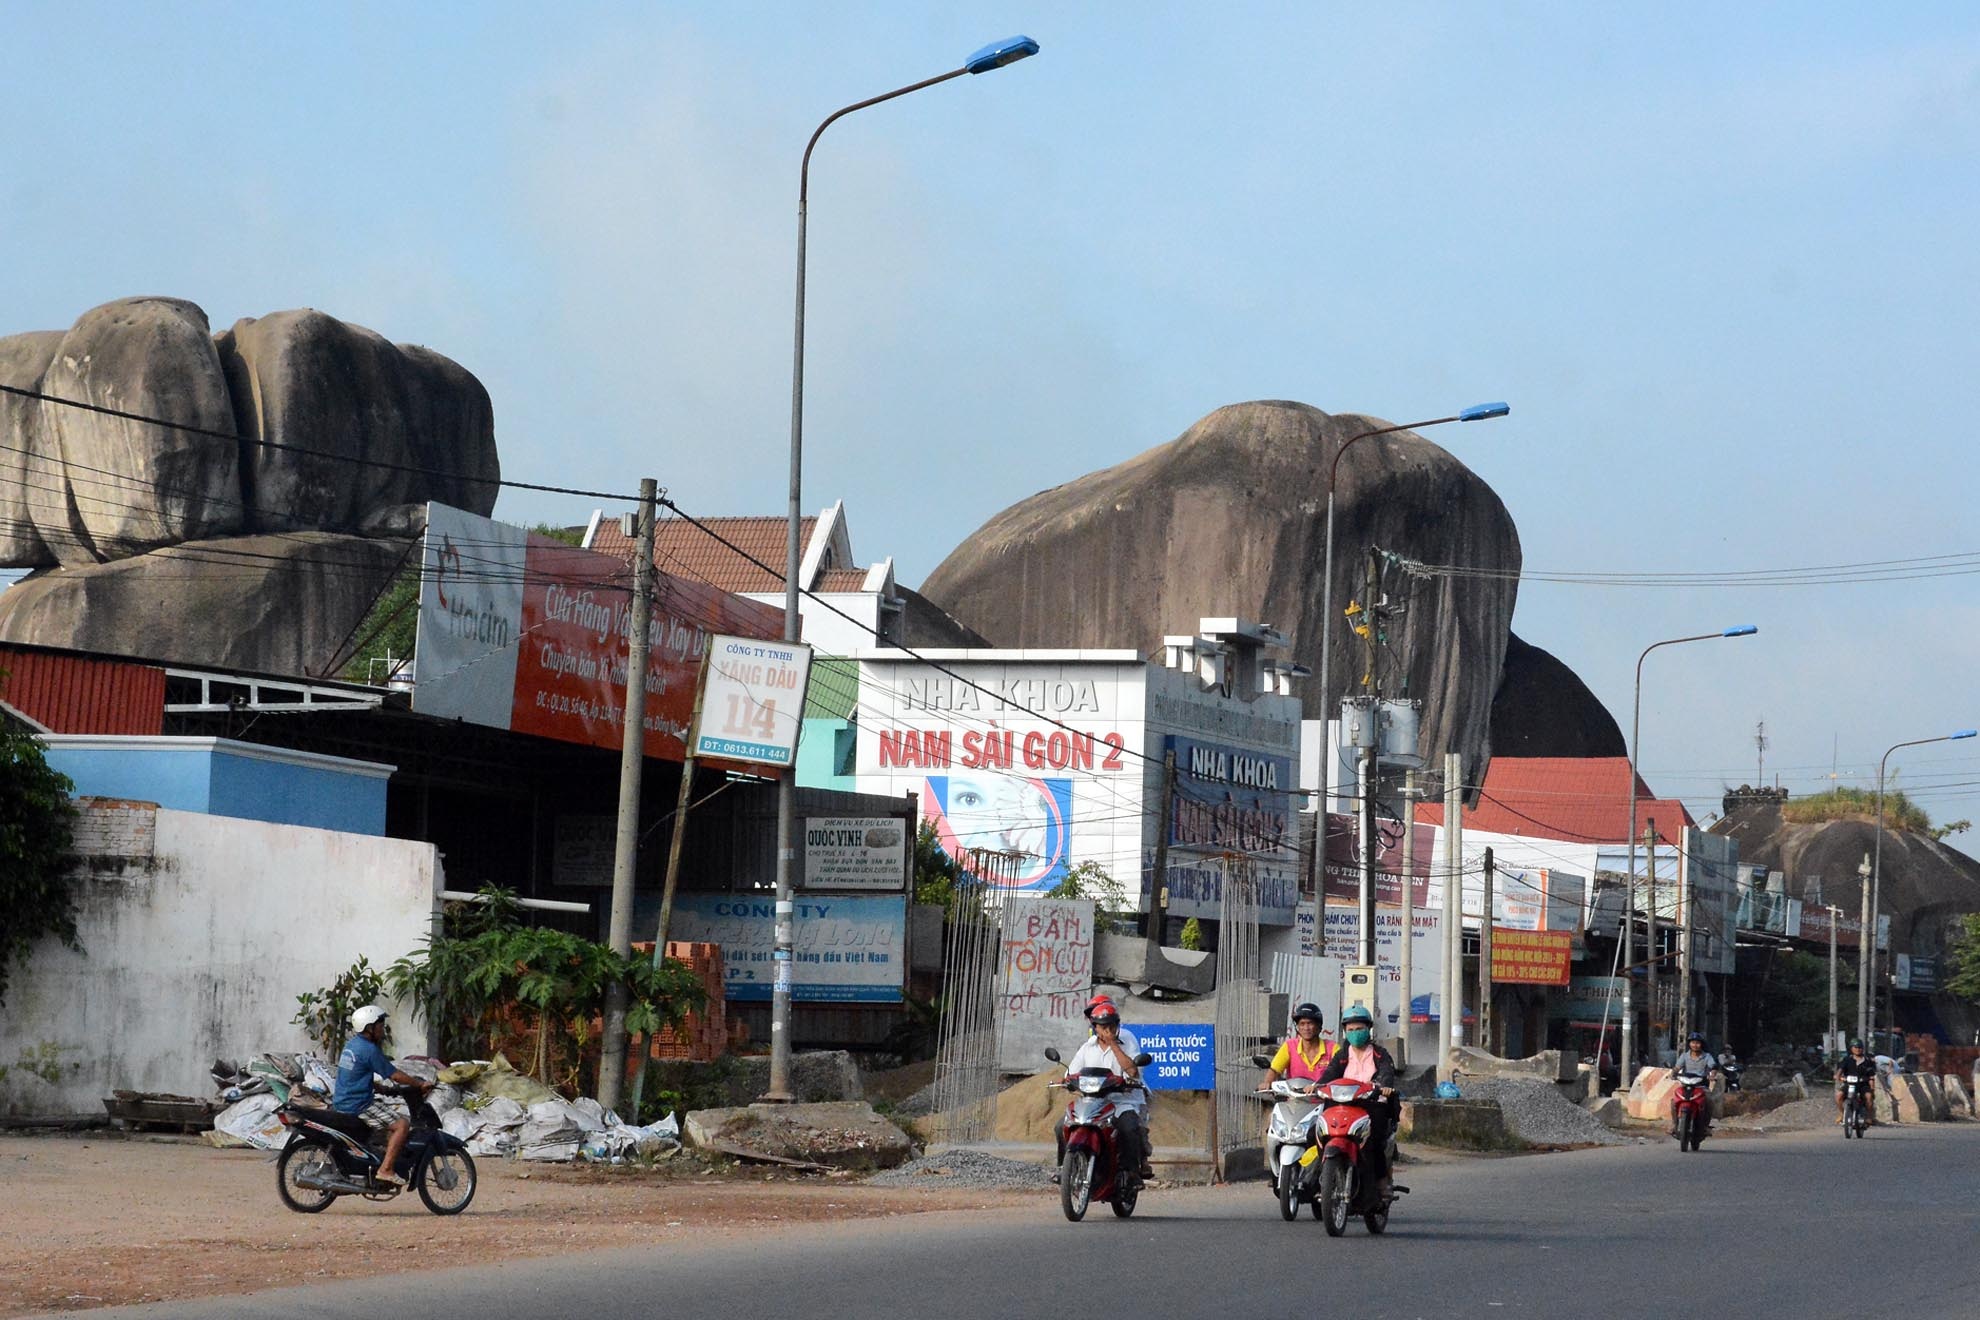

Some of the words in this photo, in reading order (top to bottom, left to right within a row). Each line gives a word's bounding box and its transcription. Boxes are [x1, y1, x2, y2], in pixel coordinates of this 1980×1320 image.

[450, 595, 508, 648] Holcim
[726, 644, 751, 656] CÔNG
[754, 648, 766, 658] TY
[768, 650, 793, 661] TNHH
[718, 660, 762, 685] XĂNG
[765, 662, 798, 690] DẦU
[903, 678, 980, 711] NHA
[994, 678, 1099, 713] KHOA
[722, 693, 777, 740] 114
[704, 740, 721, 751] ĐT:
[724, 743, 765, 756] 0613.611
[768, 749, 786, 760] 444
[879, 730, 952, 770] NAM
[961, 719, 1014, 770] SÀI
[1022, 720, 1095, 771] GÒN
[1101, 732, 1125, 771] 2
[1191, 746, 1227, 784] NHA
[1233, 755, 1277, 790] KHOA
[837, 830, 862, 847] VINH
[797, 904, 830, 918] TY
[845, 950, 865, 966] Việt
[868, 952, 889, 963] Nam
[1140, 1034, 1168, 1048] PHÍA
[1169, 1034, 1207, 1048] TRƯỚC
[1169, 1048, 1200, 1062] CÔNG
[1158, 1066, 1178, 1077] 300
[1181, 1066, 1190, 1076] M
